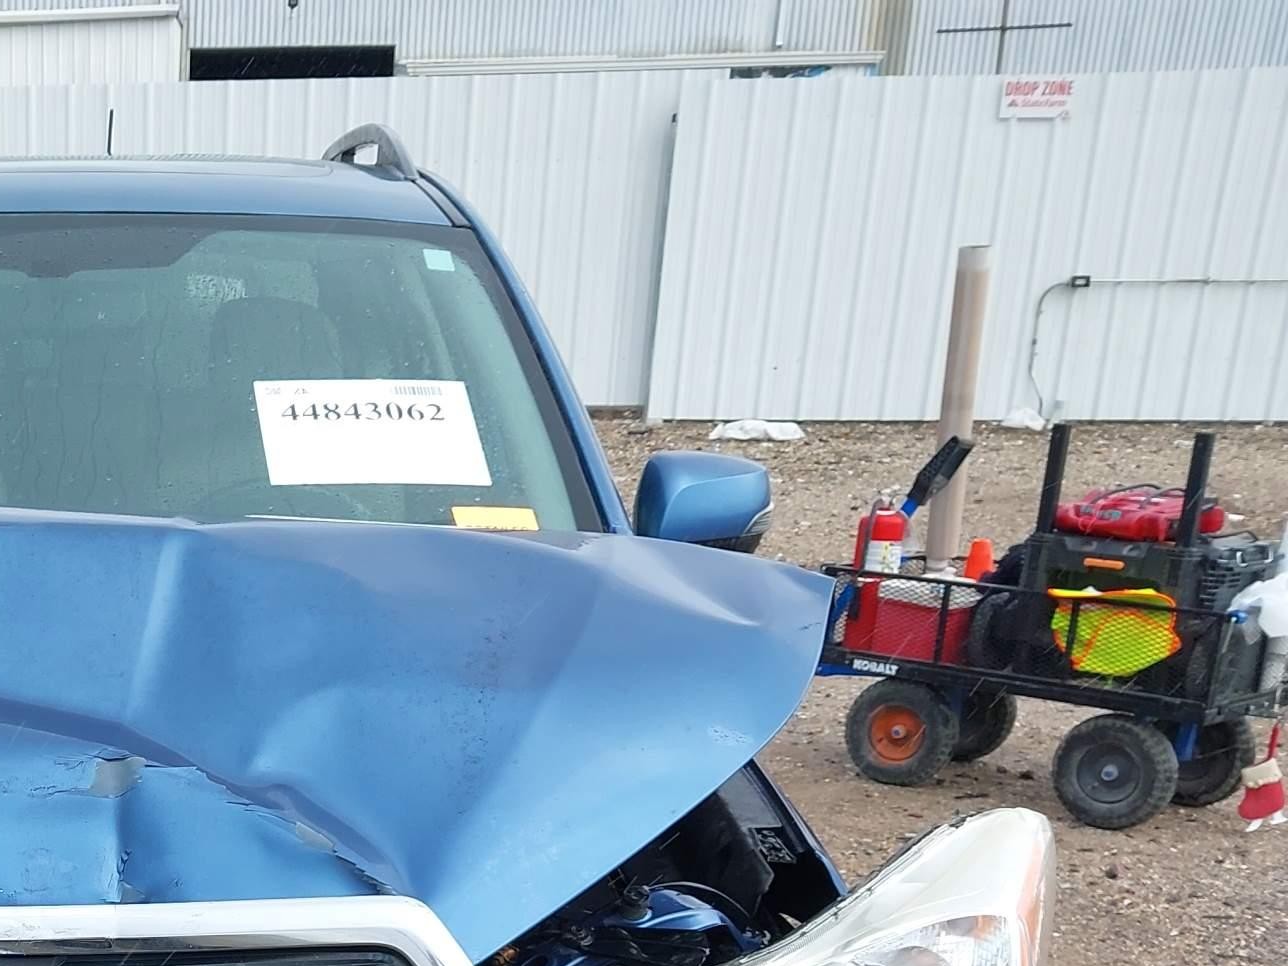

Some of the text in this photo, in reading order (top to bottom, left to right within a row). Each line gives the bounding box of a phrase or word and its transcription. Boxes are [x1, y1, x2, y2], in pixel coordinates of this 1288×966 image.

[1005, 80, 1075, 96] DROP ZONE
[281, 402, 446, 422] 44843062
[852, 658, 899, 677] KOBALT
